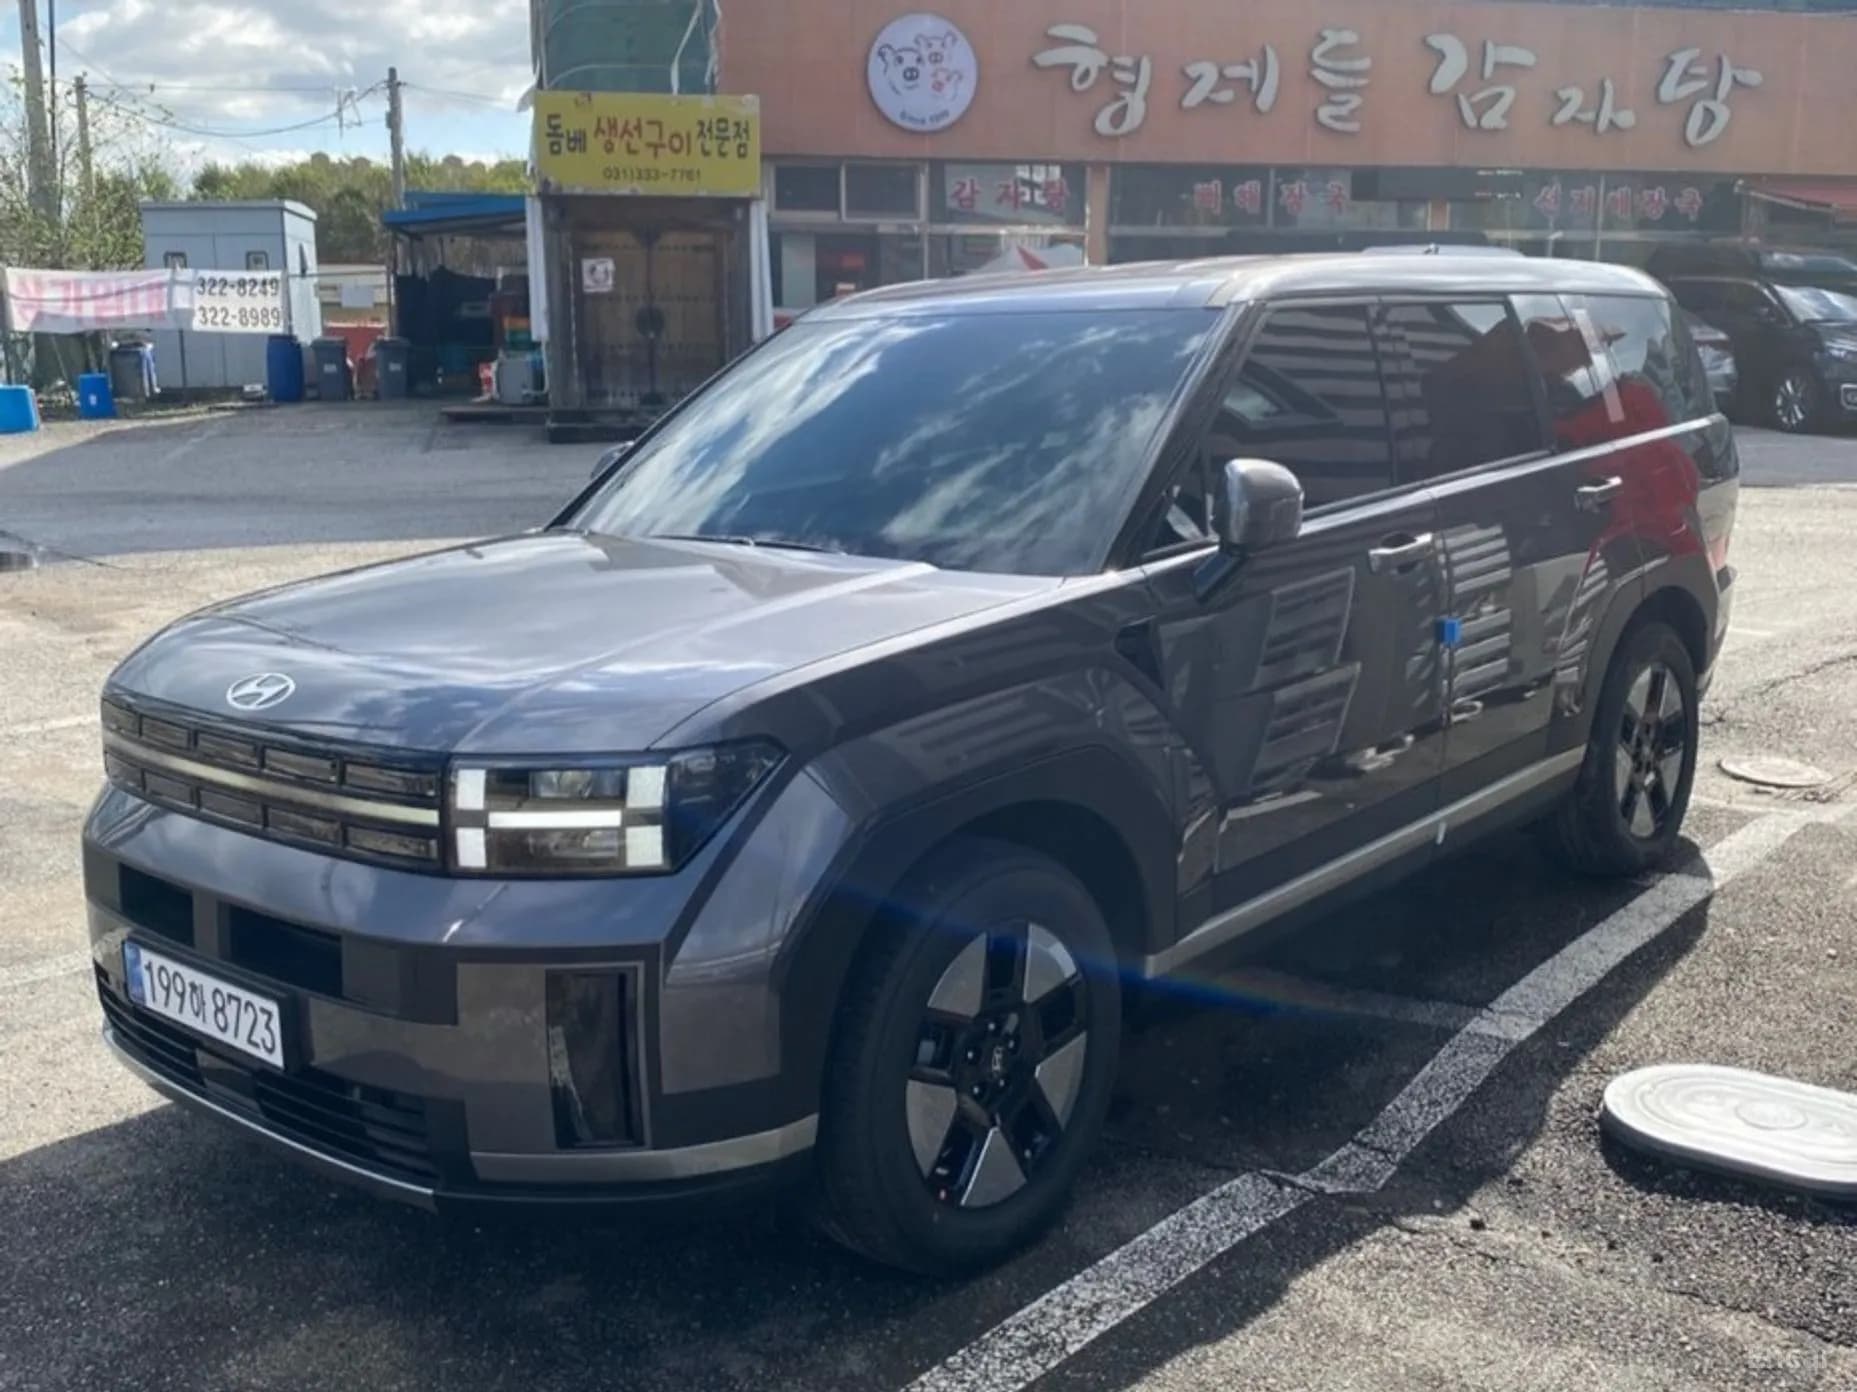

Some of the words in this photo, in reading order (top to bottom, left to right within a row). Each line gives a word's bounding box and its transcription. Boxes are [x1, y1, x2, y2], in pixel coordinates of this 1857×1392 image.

[1031, 25, 1372, 135] 형제들
[1424, 32, 1764, 146] 감자탕
[546, 114, 587, 155] 돔베
[594, 117, 691, 158] 생선구이
[697, 117, 749, 158] 전문점
[197, 276, 280, 297] 322-8249
[198, 305, 281, 328] 322-8989
[144, 960, 206, 1024] 199하
[212, 987, 276, 1055] 8723
